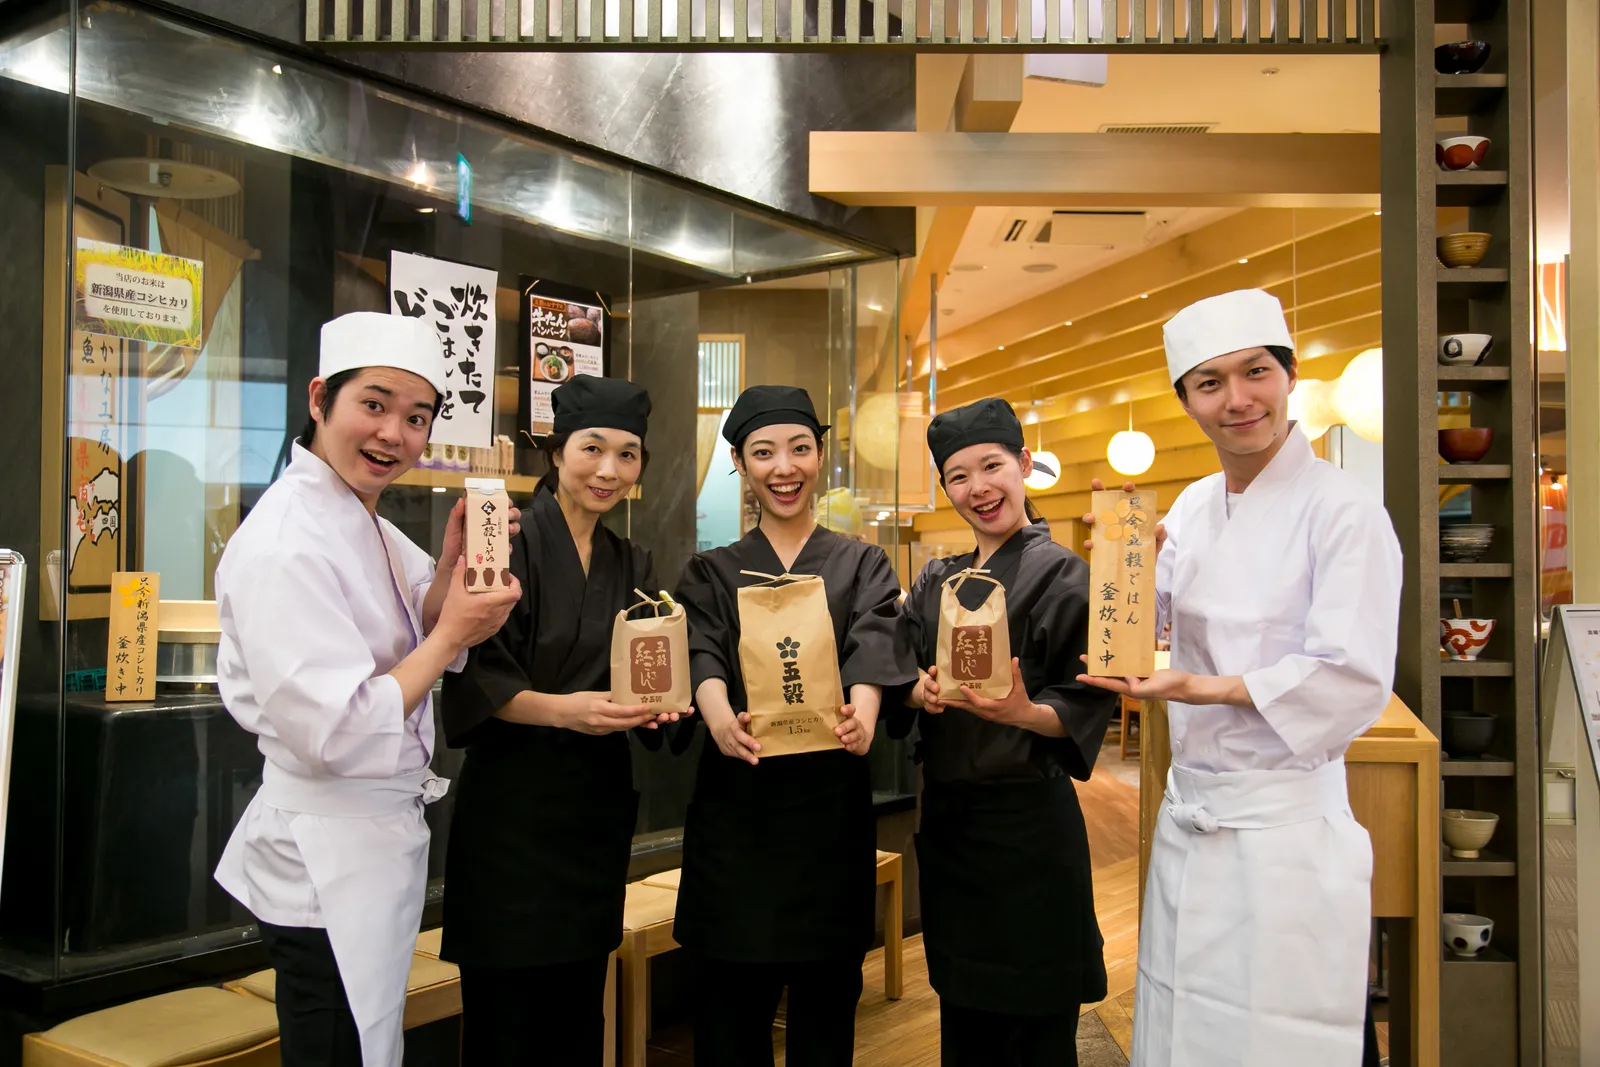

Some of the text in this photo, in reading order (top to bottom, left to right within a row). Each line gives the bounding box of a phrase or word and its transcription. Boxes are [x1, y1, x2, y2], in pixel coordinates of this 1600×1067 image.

[91, 282, 188, 309] 新潟県産コシヒカリ
[115, 272, 165, 289] 当店のお米は
[532, 306, 567, 329] 牛たん
[532, 326, 567, 339] ハンバーグ
[450, 283, 489, 413] 炊きたて
[1125, 497, 1145, 625] 只今五穀ごはん
[135, 577, 151, 696] 只今新潟県産コシヒカリ
[1099, 582, 1120, 668] 釜炊き中
[115, 636, 132, 696] 釜炊き中
[782, 661, 804, 705] 五穀
